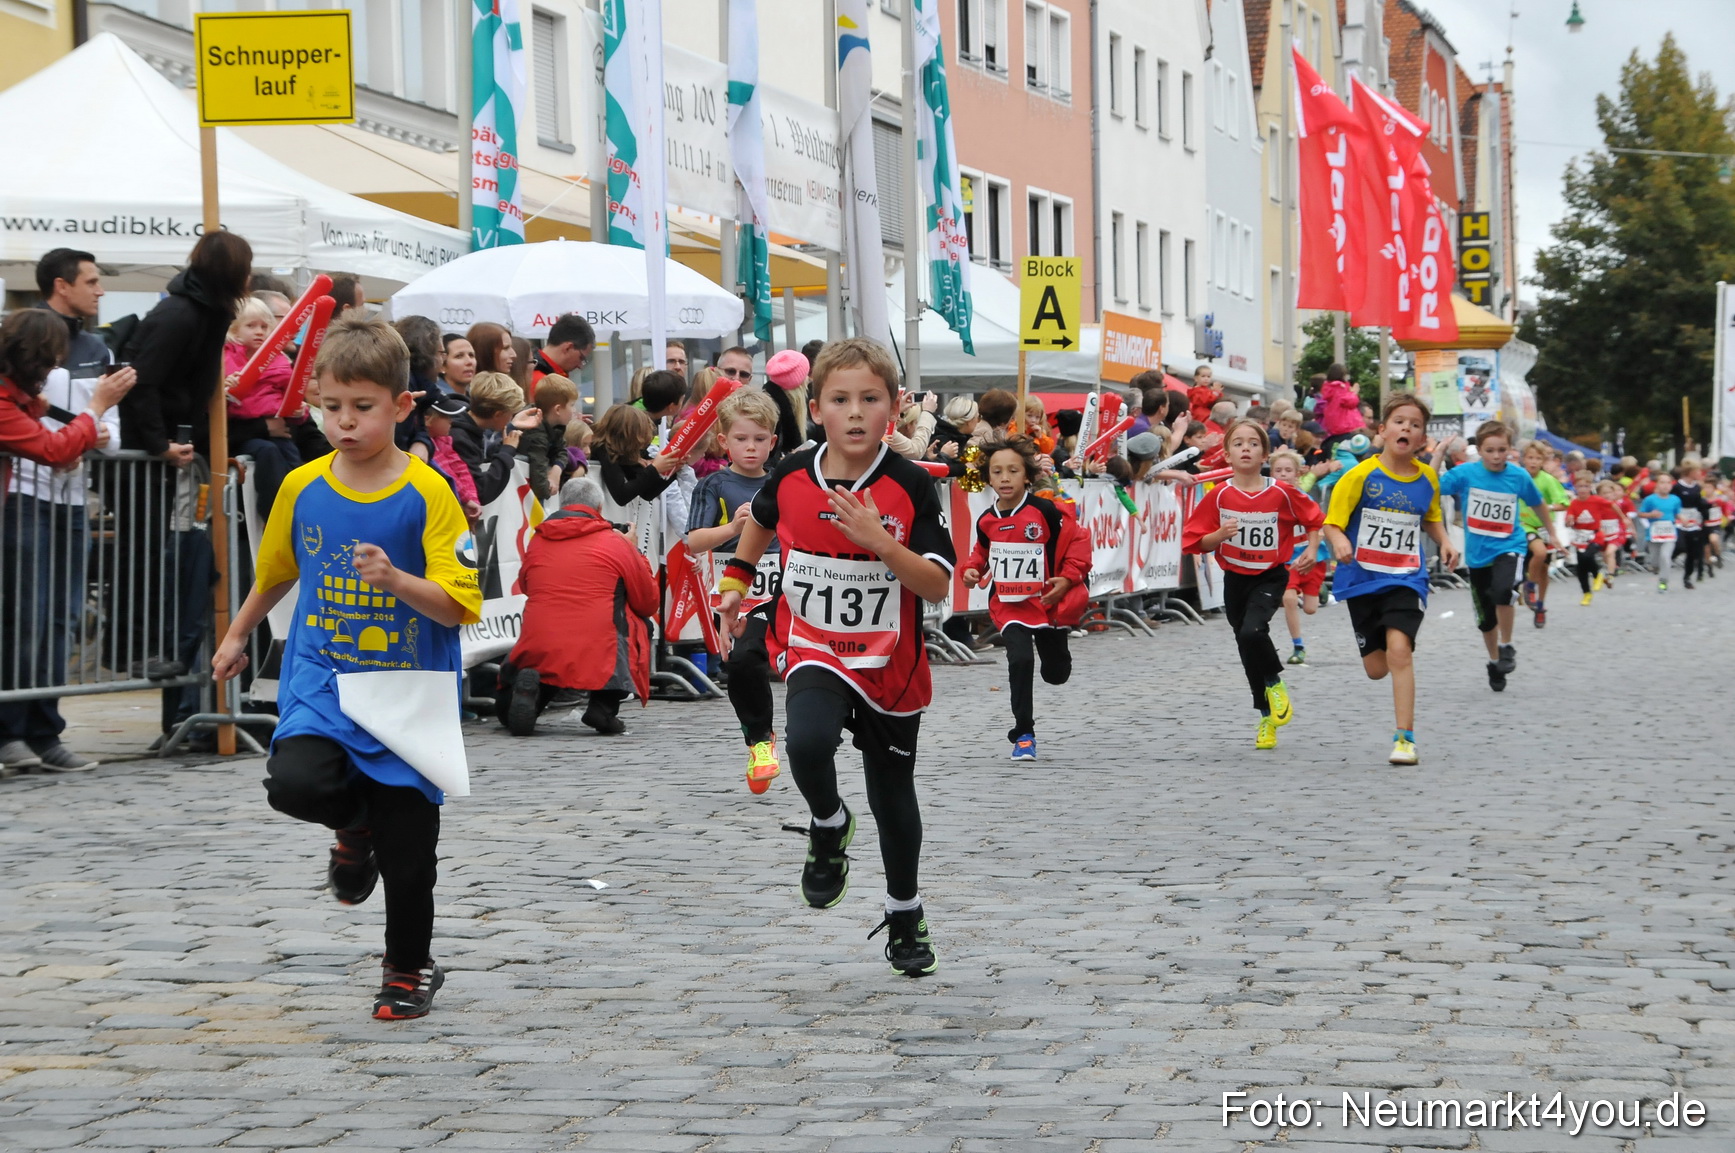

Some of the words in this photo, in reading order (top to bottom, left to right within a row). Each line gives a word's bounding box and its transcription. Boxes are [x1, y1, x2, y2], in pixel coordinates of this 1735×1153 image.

[208, 45, 341, 69] Schnupper-
[255, 74, 297, 96] lauf
[321, 221, 343, 246] Von
[415, 241, 437, 266] Audi
[1027, 260, 1074, 277] Block
[1461, 215, 1490, 303] HOT
[587, 311, 628, 325] BKK
[1032, 285, 1066, 330] A
[258, 350, 277, 373] Audi
[670, 433, 685, 451] Audi
[682, 419, 697, 435] BKK
[1473, 500, 1512, 521] 7036
[1367, 524, 1415, 551] 7514
[787, 561, 821, 578] PARTL
[824, 569, 880, 582] Neumarkt
[992, 557, 1038, 578] 7174
[1000, 585, 1023, 593] David
[793, 580, 890, 627] 7137
[373, 612, 395, 622] 2014
[889, 621, 894, 629] K
[828, 639, 856, 653] eon
